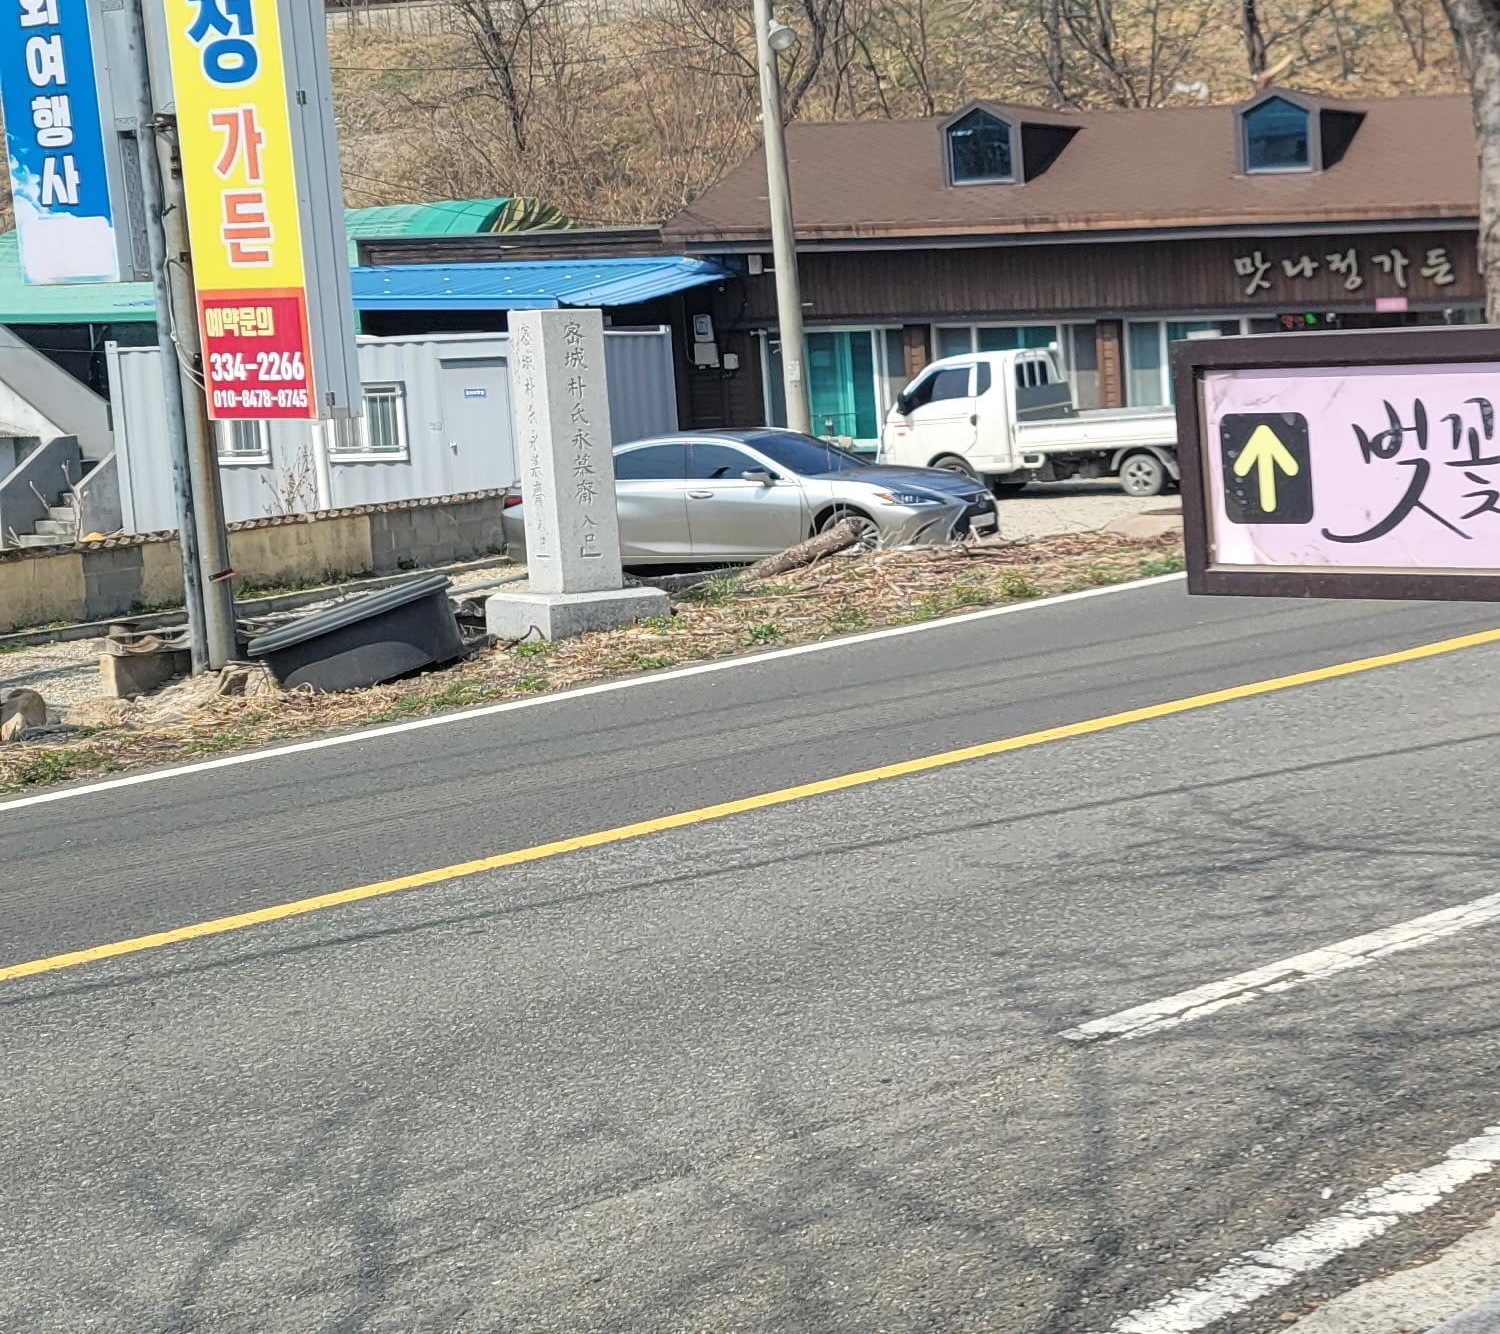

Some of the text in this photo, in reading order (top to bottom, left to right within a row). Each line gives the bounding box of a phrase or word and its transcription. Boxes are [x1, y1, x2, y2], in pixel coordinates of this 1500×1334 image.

[205, 307, 275, 337] 예약문의
[210, 351, 305, 382] 334-2266
[213, 389, 308, 408] 010-8478-8745
